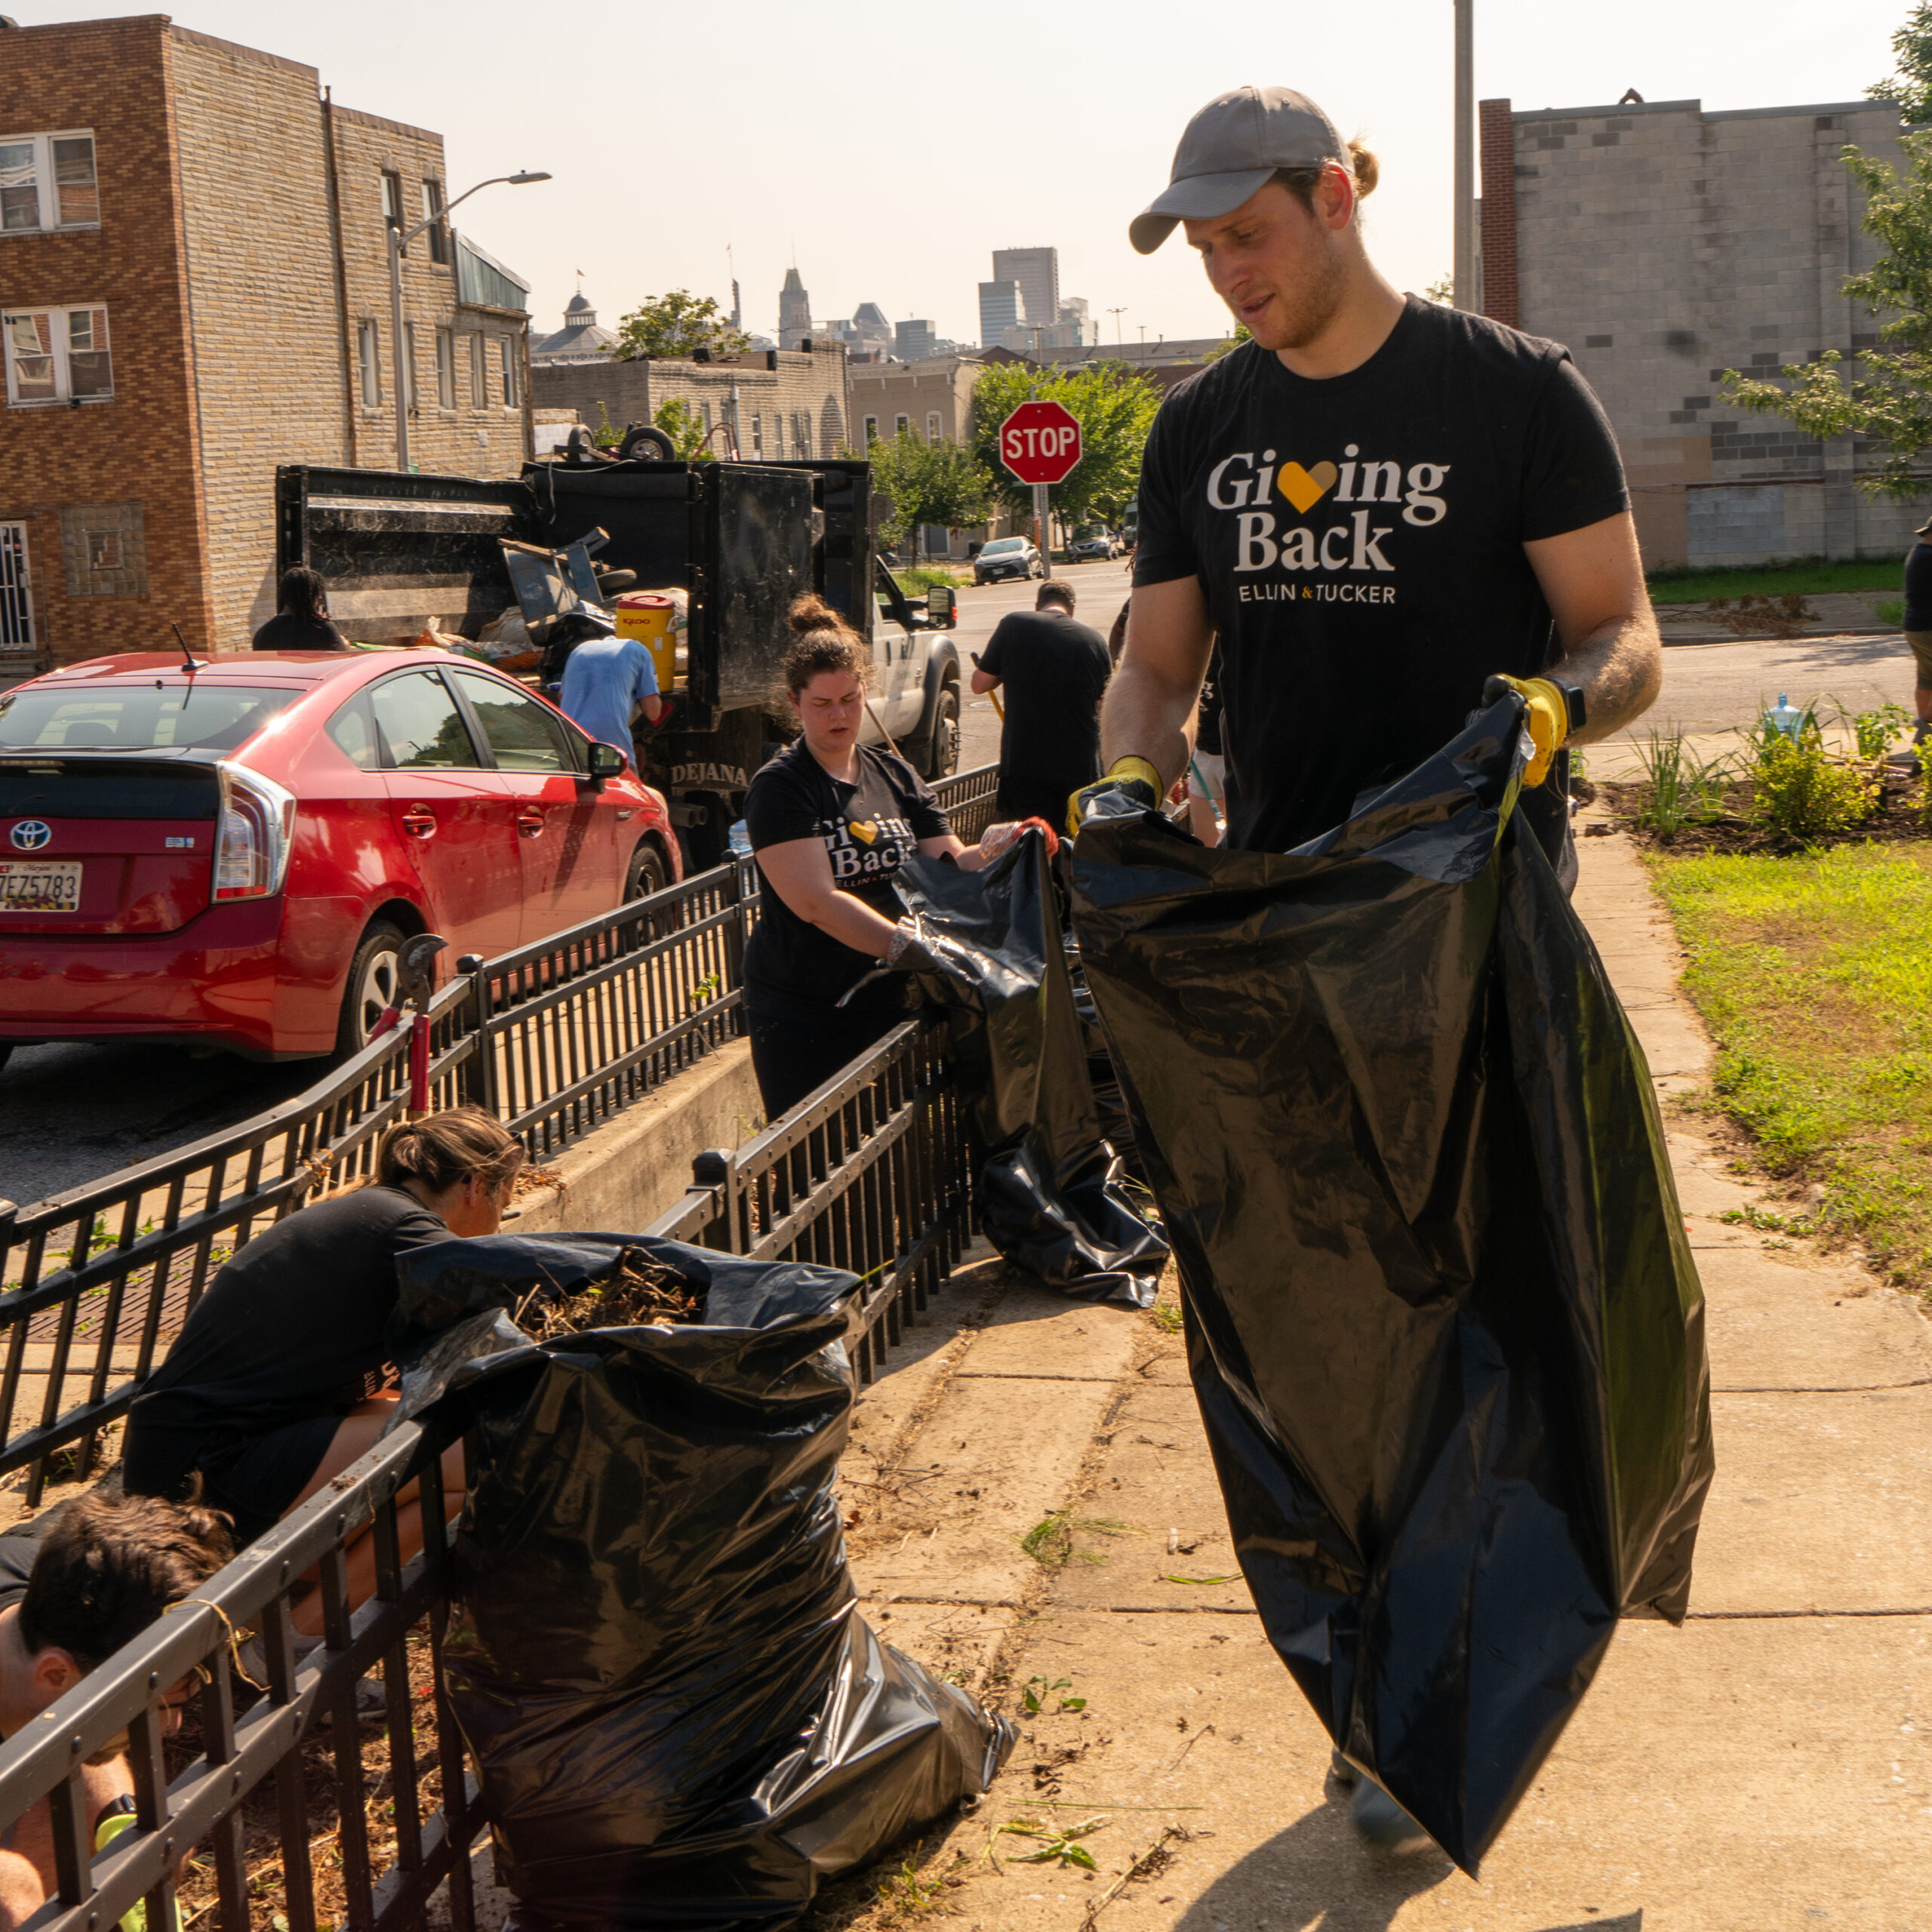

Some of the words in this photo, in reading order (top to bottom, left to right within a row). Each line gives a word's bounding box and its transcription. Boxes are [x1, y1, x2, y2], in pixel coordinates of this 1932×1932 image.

[1006, 427, 1076, 459] STOP
[1233, 509, 1395, 571] Back
[1238, 584, 1297, 602] ELLIN
[1302, 586, 1313, 599] &
[1316, 585, 1396, 605] TUCKER
[670, 763, 750, 788] DEJANA
[835, 877, 870, 888] ELLIN
